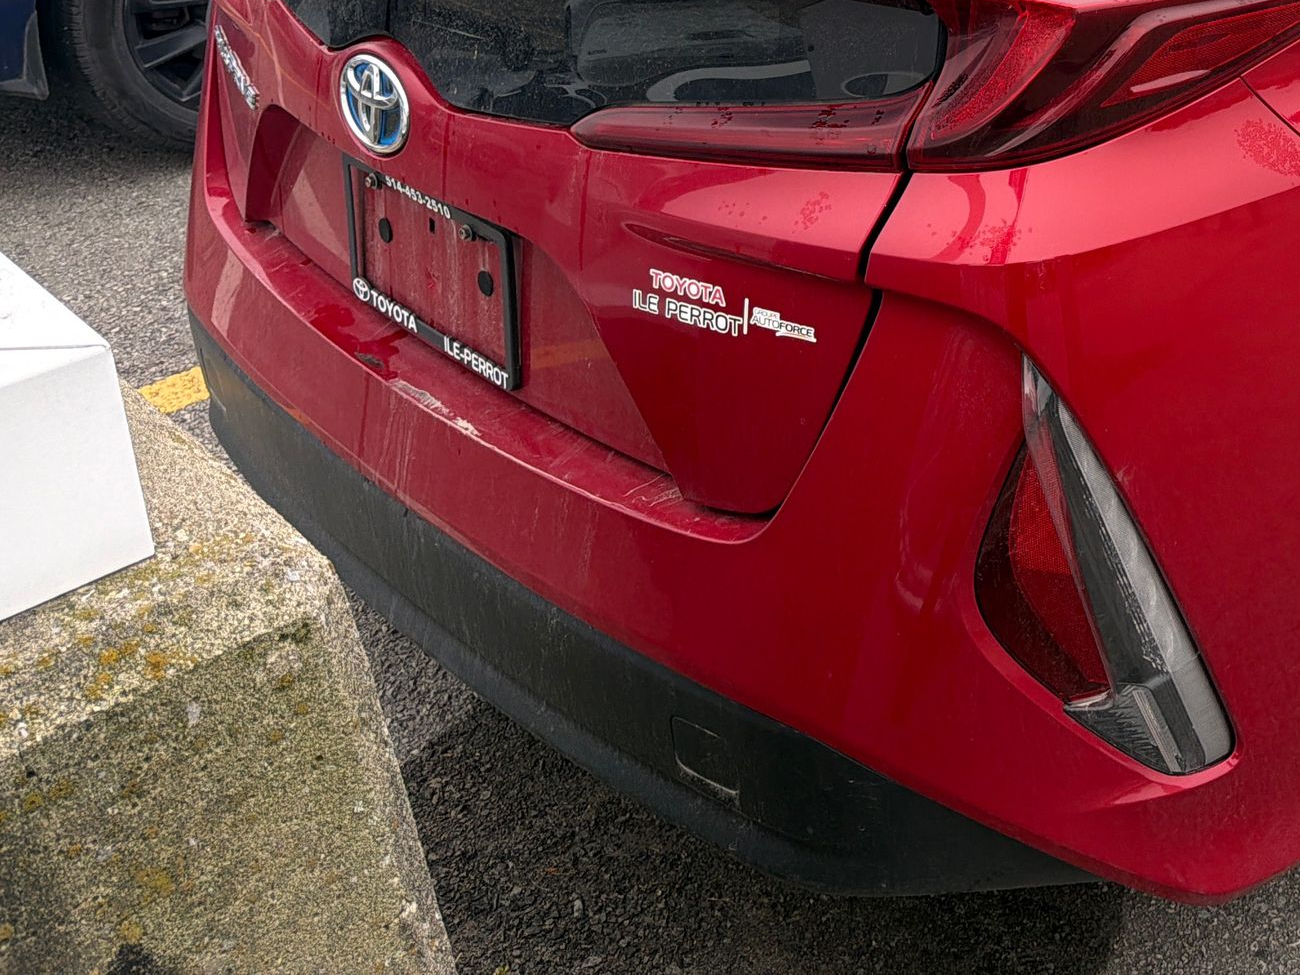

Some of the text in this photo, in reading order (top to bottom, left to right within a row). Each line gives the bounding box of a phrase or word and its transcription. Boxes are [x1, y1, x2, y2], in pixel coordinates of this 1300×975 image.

[384, 175, 451, 220] 514-453-2510
[650, 269, 726, 307] TOYOTA
[371, 290, 418, 333] TOYOTA
[632, 289, 743, 337] ILE PERROT
[751, 314, 814, 338] AUTOFORCE
[443, 336, 509, 389] ILE-PERROT
